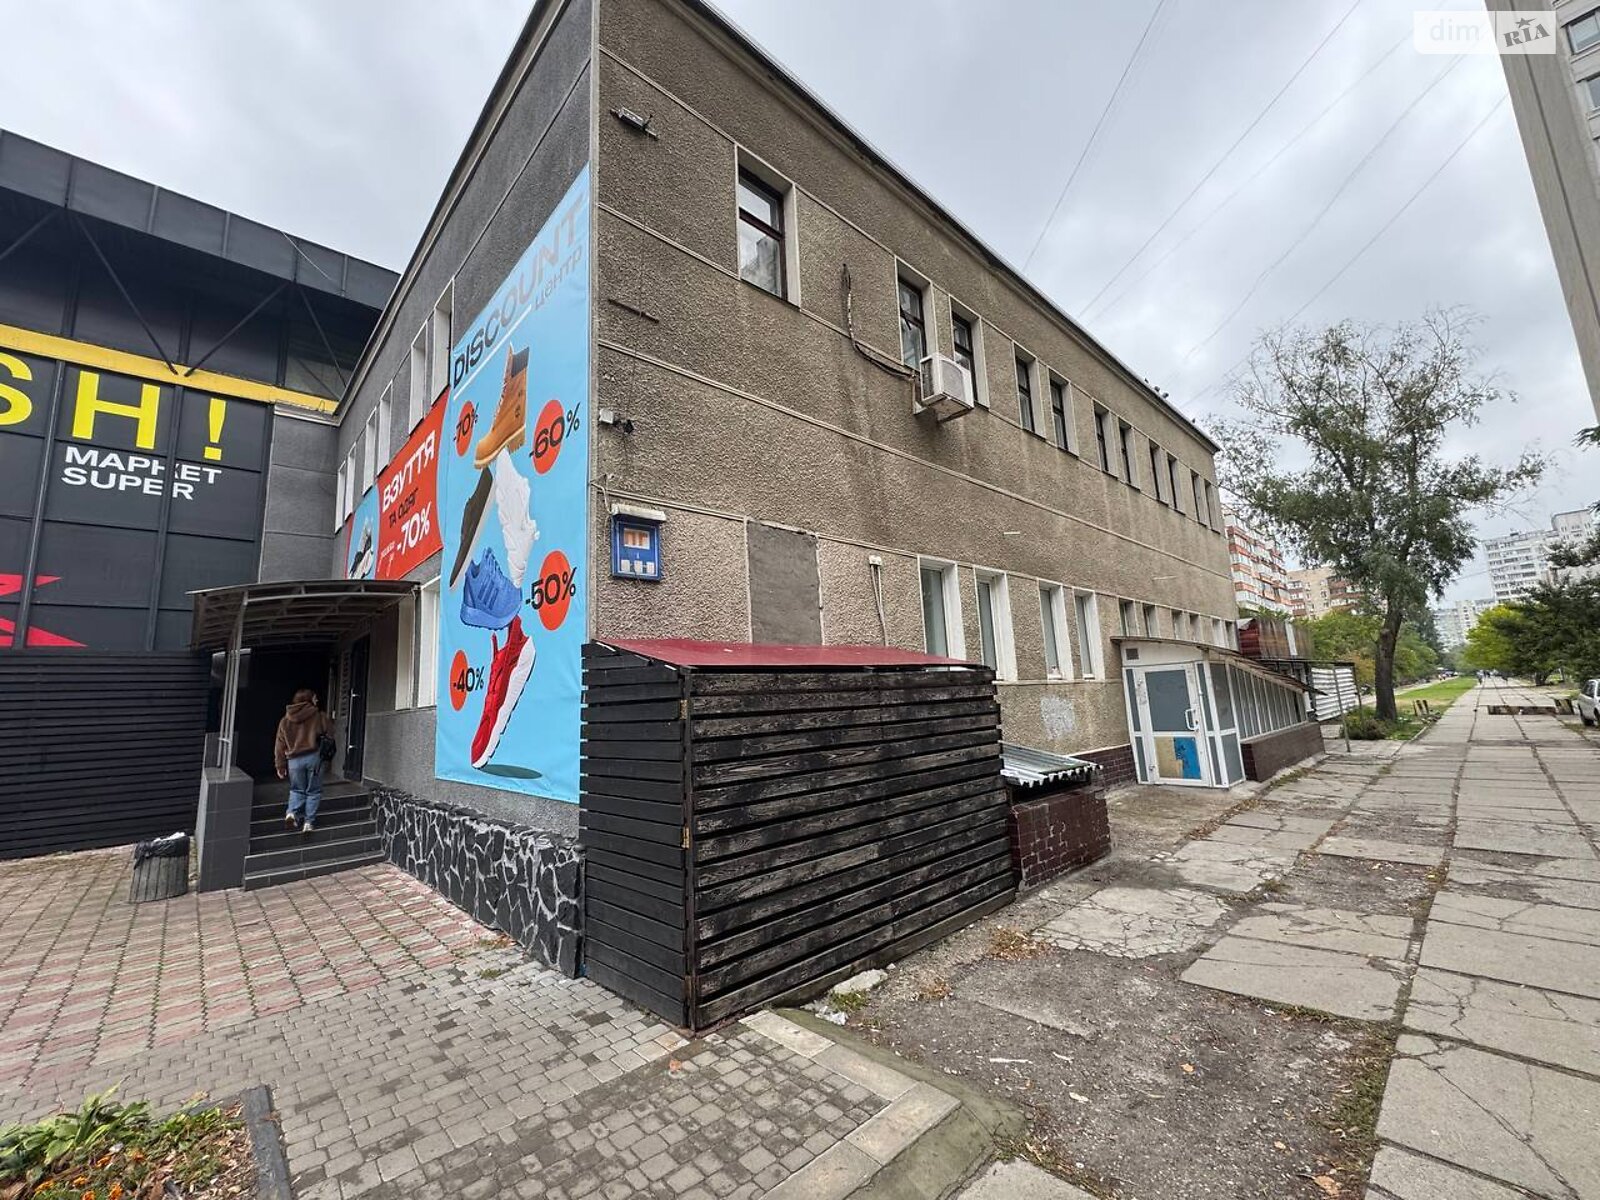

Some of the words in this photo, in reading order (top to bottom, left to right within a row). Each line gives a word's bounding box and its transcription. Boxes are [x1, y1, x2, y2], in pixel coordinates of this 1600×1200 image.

[453, 191, 584, 389] DISCOUNT
[529, 401, 581, 458] -60%
[61, 467, 195, 500] SUPER
[382, 429, 436, 512] ВЗУТТЯ
[397, 501, 432, 556] -70%
[525, 566, 577, 610] -50%
[453, 666, 485, 692] -40%
